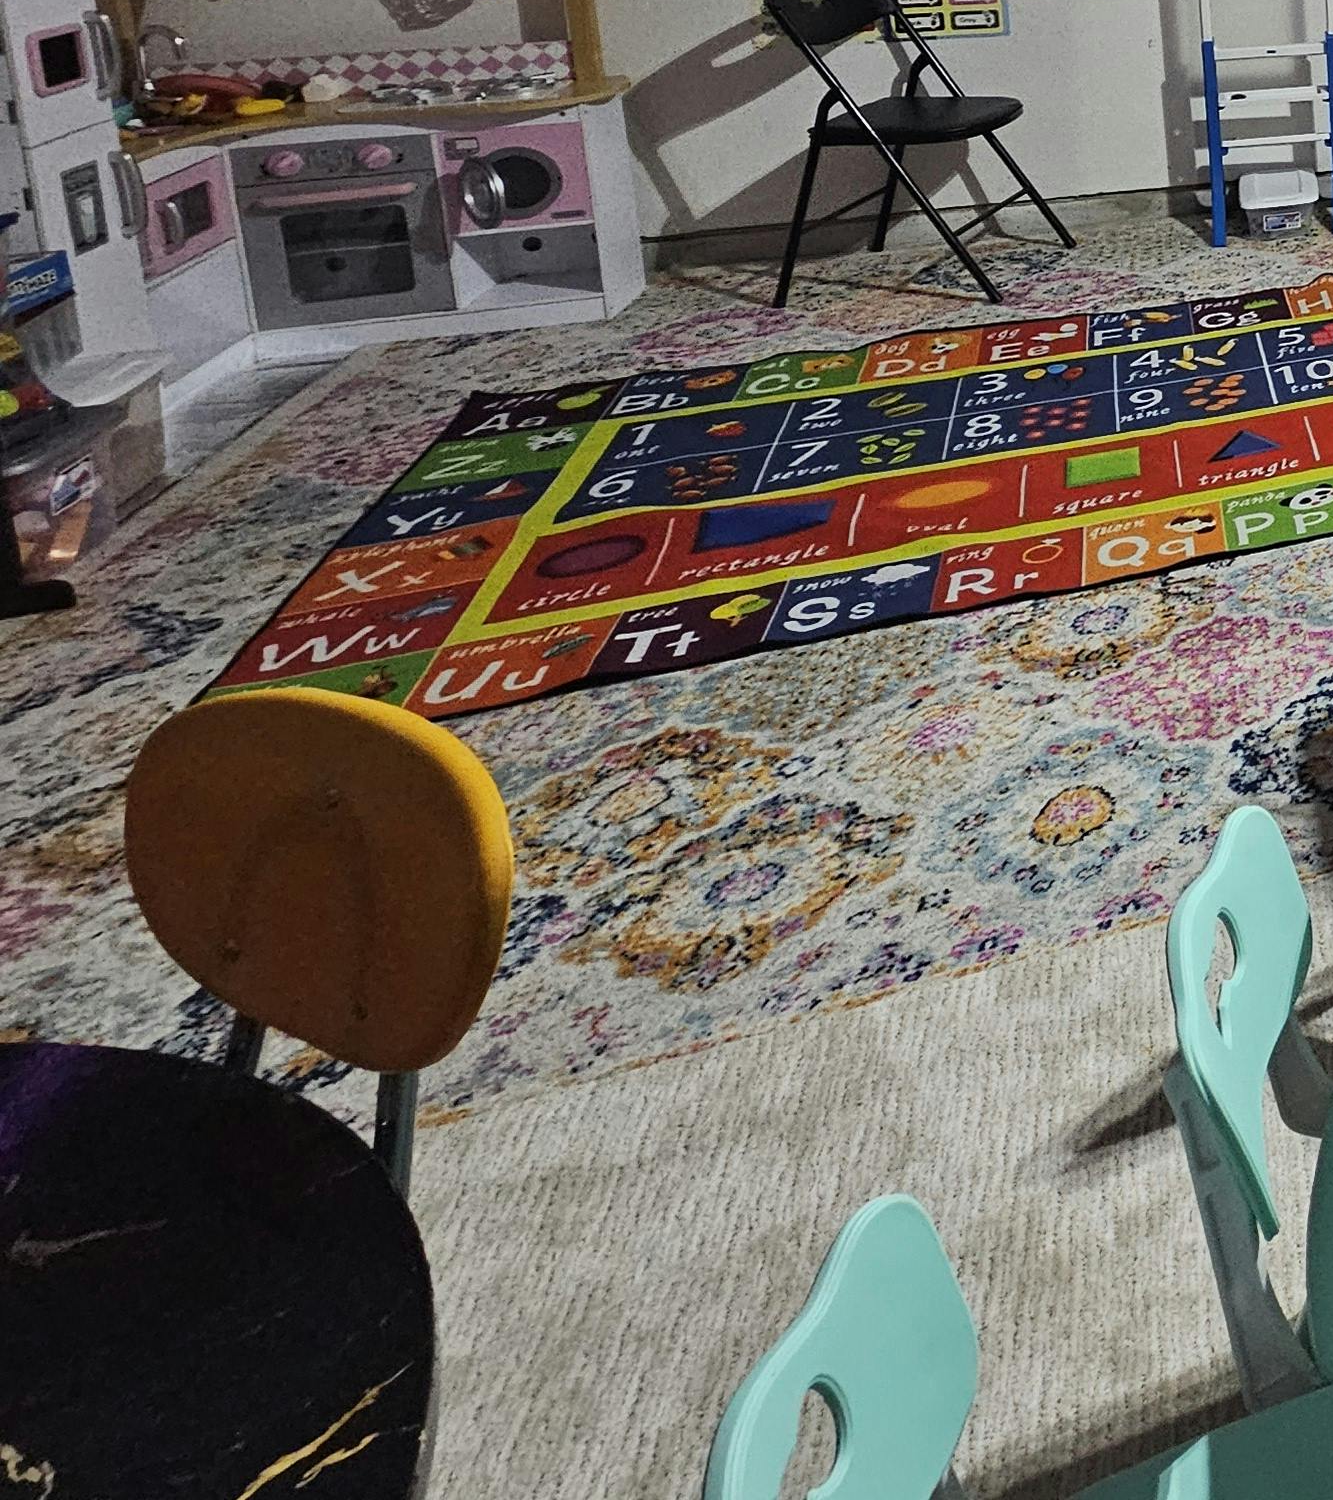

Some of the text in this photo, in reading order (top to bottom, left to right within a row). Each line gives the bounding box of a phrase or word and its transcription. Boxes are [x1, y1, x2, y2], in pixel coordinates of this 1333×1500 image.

[1192, 299, 1240, 314] grass
[1198, 311, 1261, 328] Gg
[986, 327, 1021, 342] egg
[1092, 327, 1147, 346] Ff
[1278, 327, 1305, 347] 5
[874, 340, 910, 356] dog
[989, 342, 1050, 362] Ee
[1129, 350, 1160, 368] 4
[873, 355, 947, 378] Dd
[1124, 366, 1177, 385] four
[973, 373, 1009, 395] 3
[610, 392, 690, 416] Bb
[801, 398, 842, 422] 2
[963, 390, 1027, 407] three
[1128, 388, 1163, 410] 9
[462, 412, 548, 436] Aa
[631, 423, 656, 446] 1
[964, 414, 1003, 438] 8
[788, 440, 830, 467] 7
[953, 432, 1019, 452] eight
[421, 454, 508, 481] Zz
[767, 464, 840, 483] seven
[1198, 458, 1300, 486] triangle
[588, 469, 638, 498] 6
[1052, 488, 1143, 515] square
[1226, 491, 1287, 513] panda
[386, 506, 465, 536] Yy
[905, 517, 968, 534] oval
[1088, 518, 1146, 539] queen
[678, 544, 830, 580] rectangle
[946, 545, 994, 564] ring
[1097, 535, 1196, 568] Qq
[790, 574, 853, 595] snow
[944, 568, 1039, 603] Rr
[517, 583, 612, 612] circle
[628, 605, 679, 623] tree
[783, 596, 875, 632] Ss
[259, 625, 422, 672] Ww
[448, 624, 582, 660] umbrella
[614, 623, 700, 664] Tt
[423, 659, 550, 704] Uu
